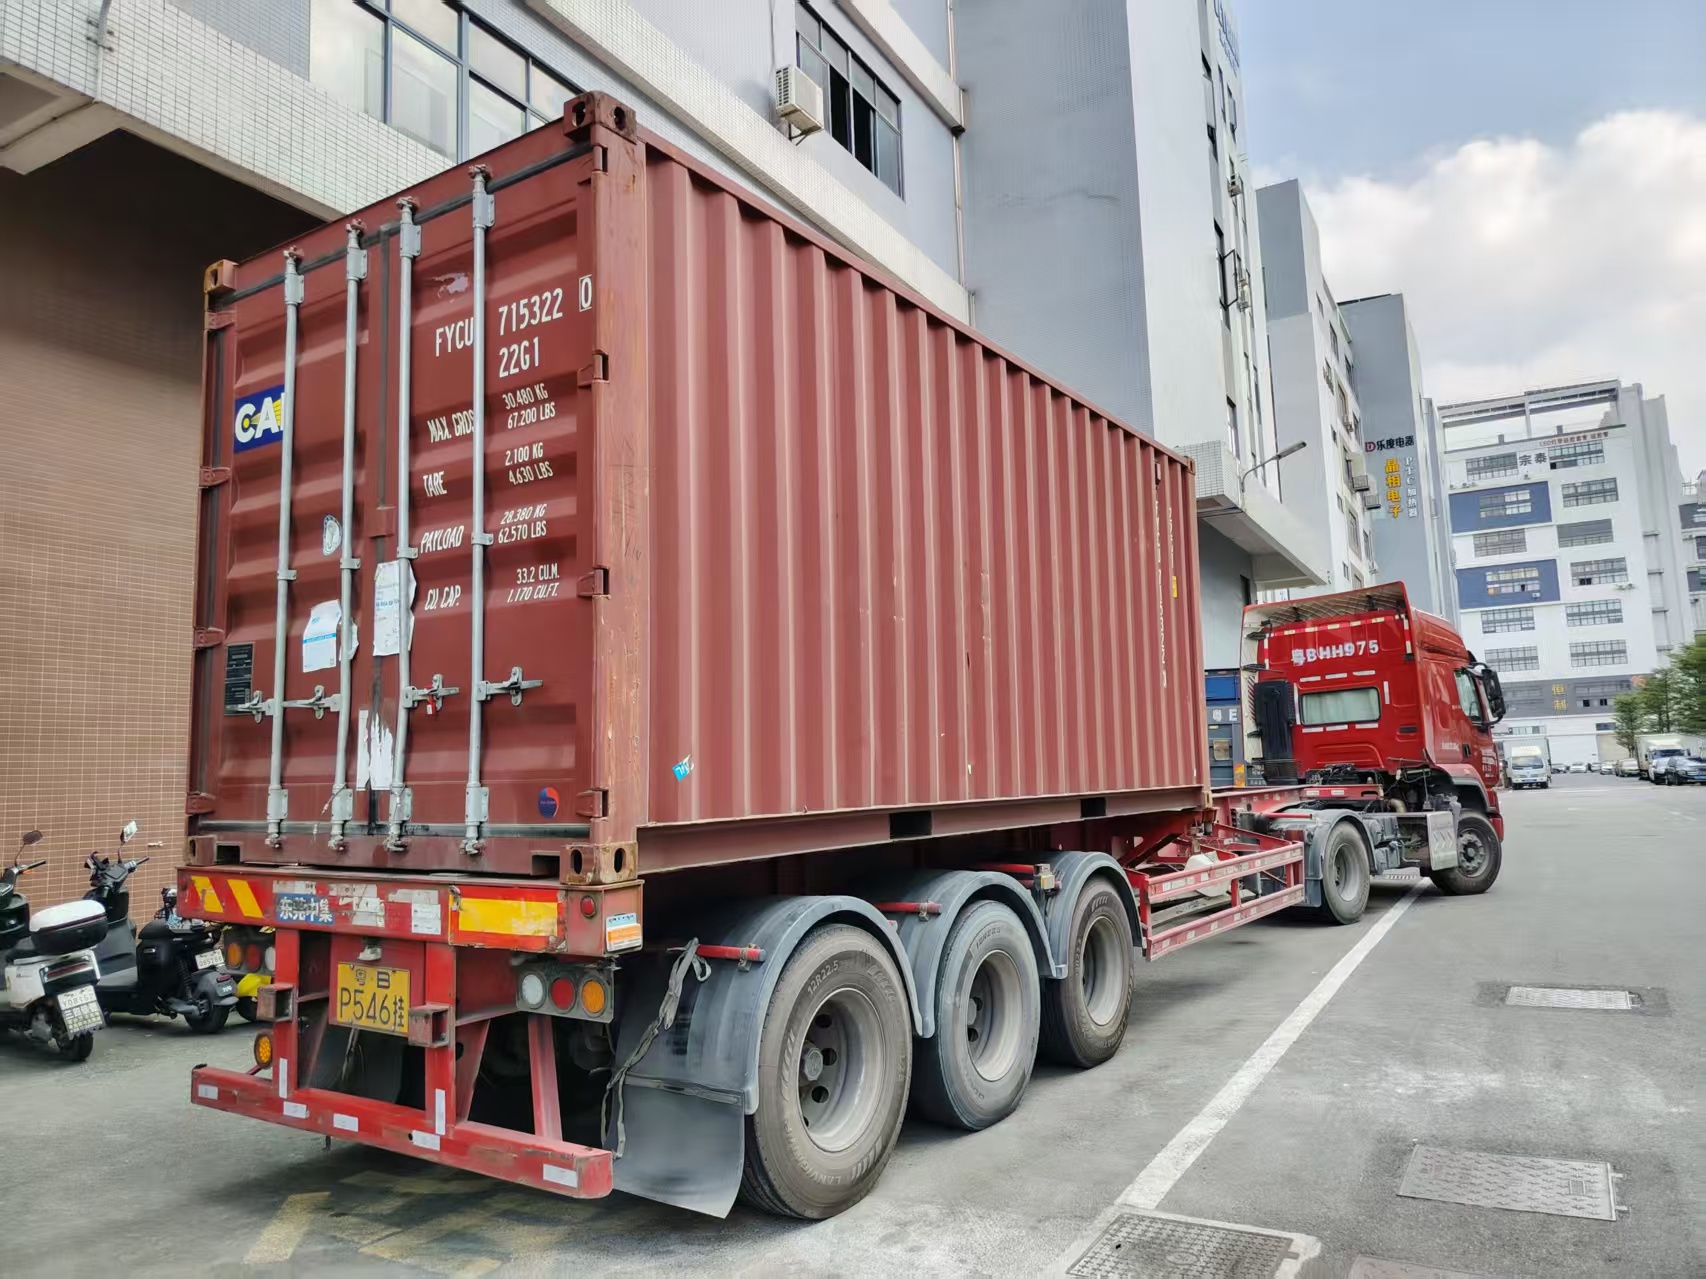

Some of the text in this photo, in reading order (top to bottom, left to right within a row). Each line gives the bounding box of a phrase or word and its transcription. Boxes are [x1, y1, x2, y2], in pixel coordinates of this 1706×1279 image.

[435, 276, 593, 357] FYCU 715322 0
[499, 336, 539, 378] 22G1
[502, 383, 548, 410] 30.480 KG
[427, 415, 452, 443] MAX.
[507, 402, 556, 429] 67.200 LBS
[505, 442, 543, 466] 2.100 KG
[1376, 435, 1415, 451] 乐度电器
[423, 471, 447, 498] TARE
[508, 461, 554, 486] 4.630 LBS
[1385, 457, 1401, 518] 晶相电子
[500, 503, 547, 525] 28.380 KG
[420, 525, 465, 554] PAYLOAD
[498, 520, 547, 544] 62.570 LBS
[516, 562, 560, 585] 33.2 CU.M.
[440, 585, 462, 609] CAP.
[1291, 639, 1379, 666] 粤BHH975
[340, 987, 405, 1029] P546挂
